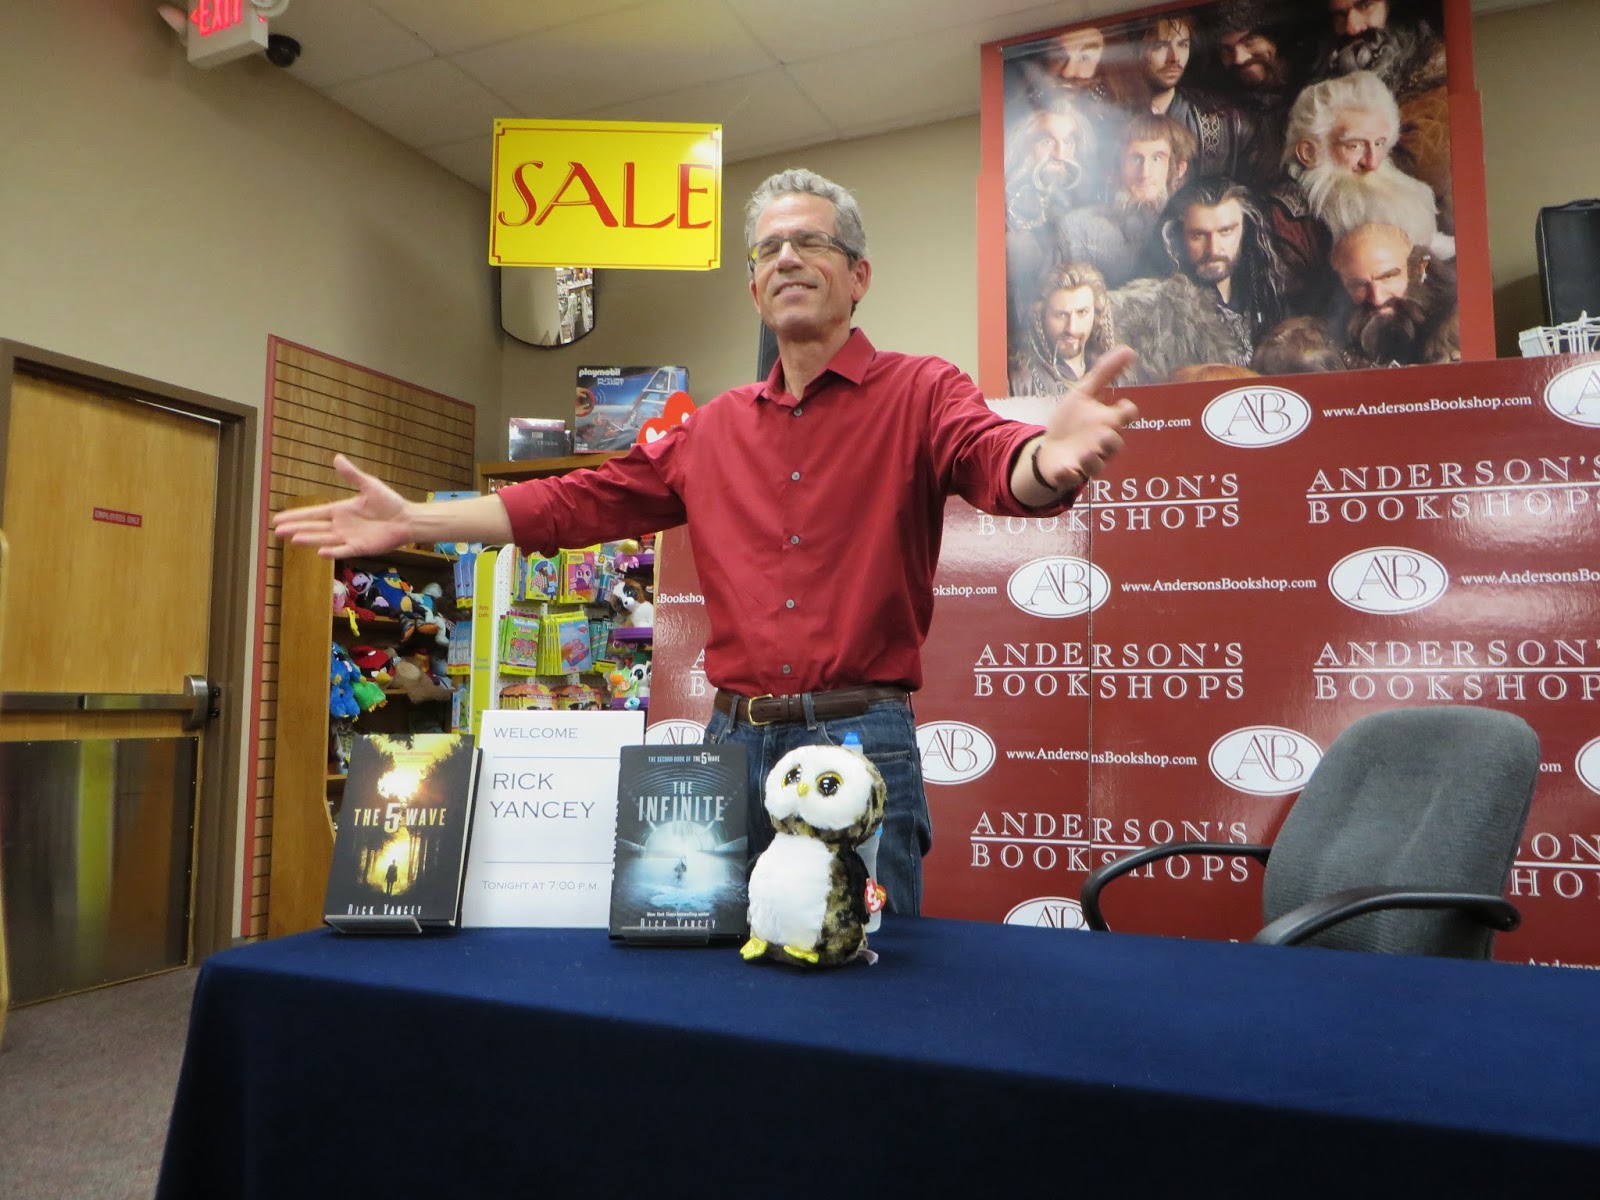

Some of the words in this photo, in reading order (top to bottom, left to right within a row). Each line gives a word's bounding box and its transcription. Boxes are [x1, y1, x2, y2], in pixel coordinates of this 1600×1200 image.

[498, 160, 713, 230] SALE
[578, 367, 621, 378] playmobil
[1322, 395, 1532, 418] www.AndersonsBookshop.com
[1308, 488, 1600, 524] BOOKSHOP
[1121, 577, 1317, 592] www.AndersonsBookshop.com
[975, 642, 1243, 667] ANDERSON'S
[974, 673, 1244, 699] BOOKSHOPS
[493, 727, 579, 739] WELCOME
[1006, 747, 1197, 767] www.AndersonsBookshop.com
[492, 773, 554, 790] RICK
[673, 782, 692, 794] THE
[354, 808, 381, 826] THE
[406, 808, 447, 826] WAVE
[490, 801, 595, 819] YANCEY
[639, 796, 725, 821] INFINITE
[971, 811, 1247, 844] ANDERSON'S
[548, 881, 575, 890] 7:00
[347, 904, 374, 915] RICK
[384, 904, 422, 915] YANCEY
[677, 918, 716, 930] YANCEY
